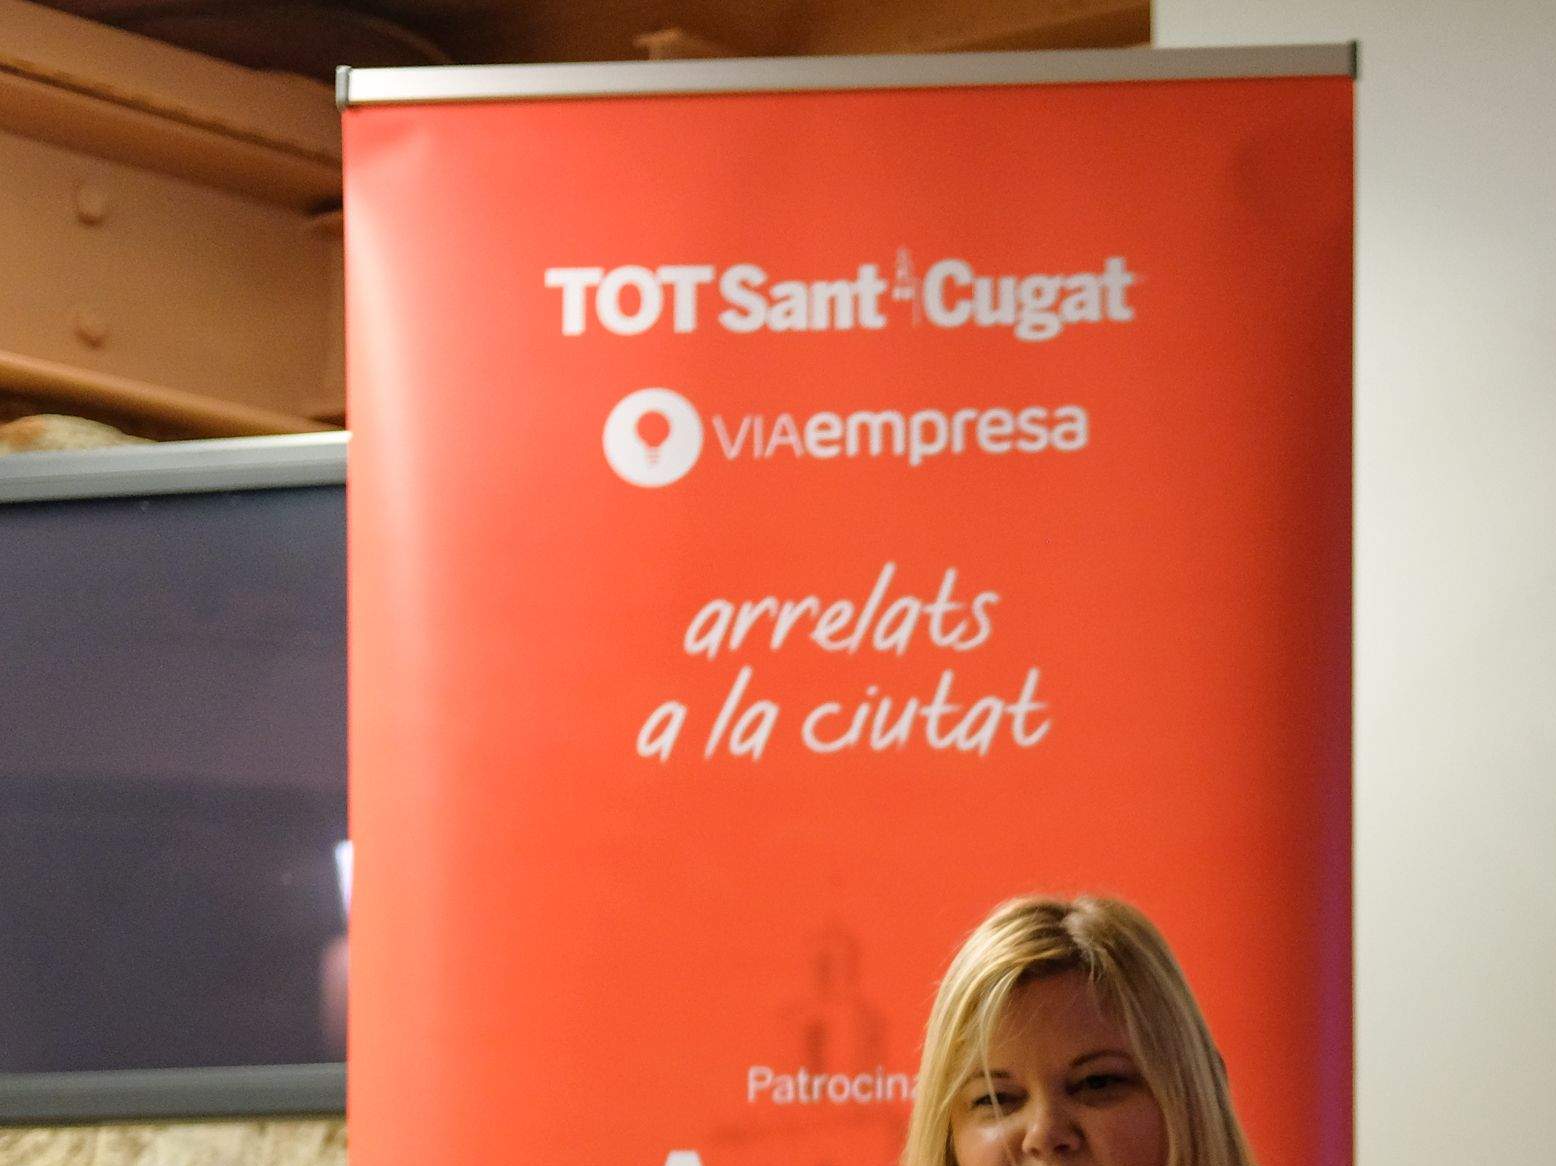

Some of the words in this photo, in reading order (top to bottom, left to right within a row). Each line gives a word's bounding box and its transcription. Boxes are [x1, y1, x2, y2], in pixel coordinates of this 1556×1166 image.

[545, 265, 713, 336] TOT
[719, 263, 887, 332] Sant
[924, 256, 1134, 342] Cugat
[684, 562, 999, 660] arrelats
[635, 701, 687, 762] a
[705, 665, 778, 762] la
[801, 667, 1050, 757] ciutat
[747, 1065, 920, 1104] Patrocin
